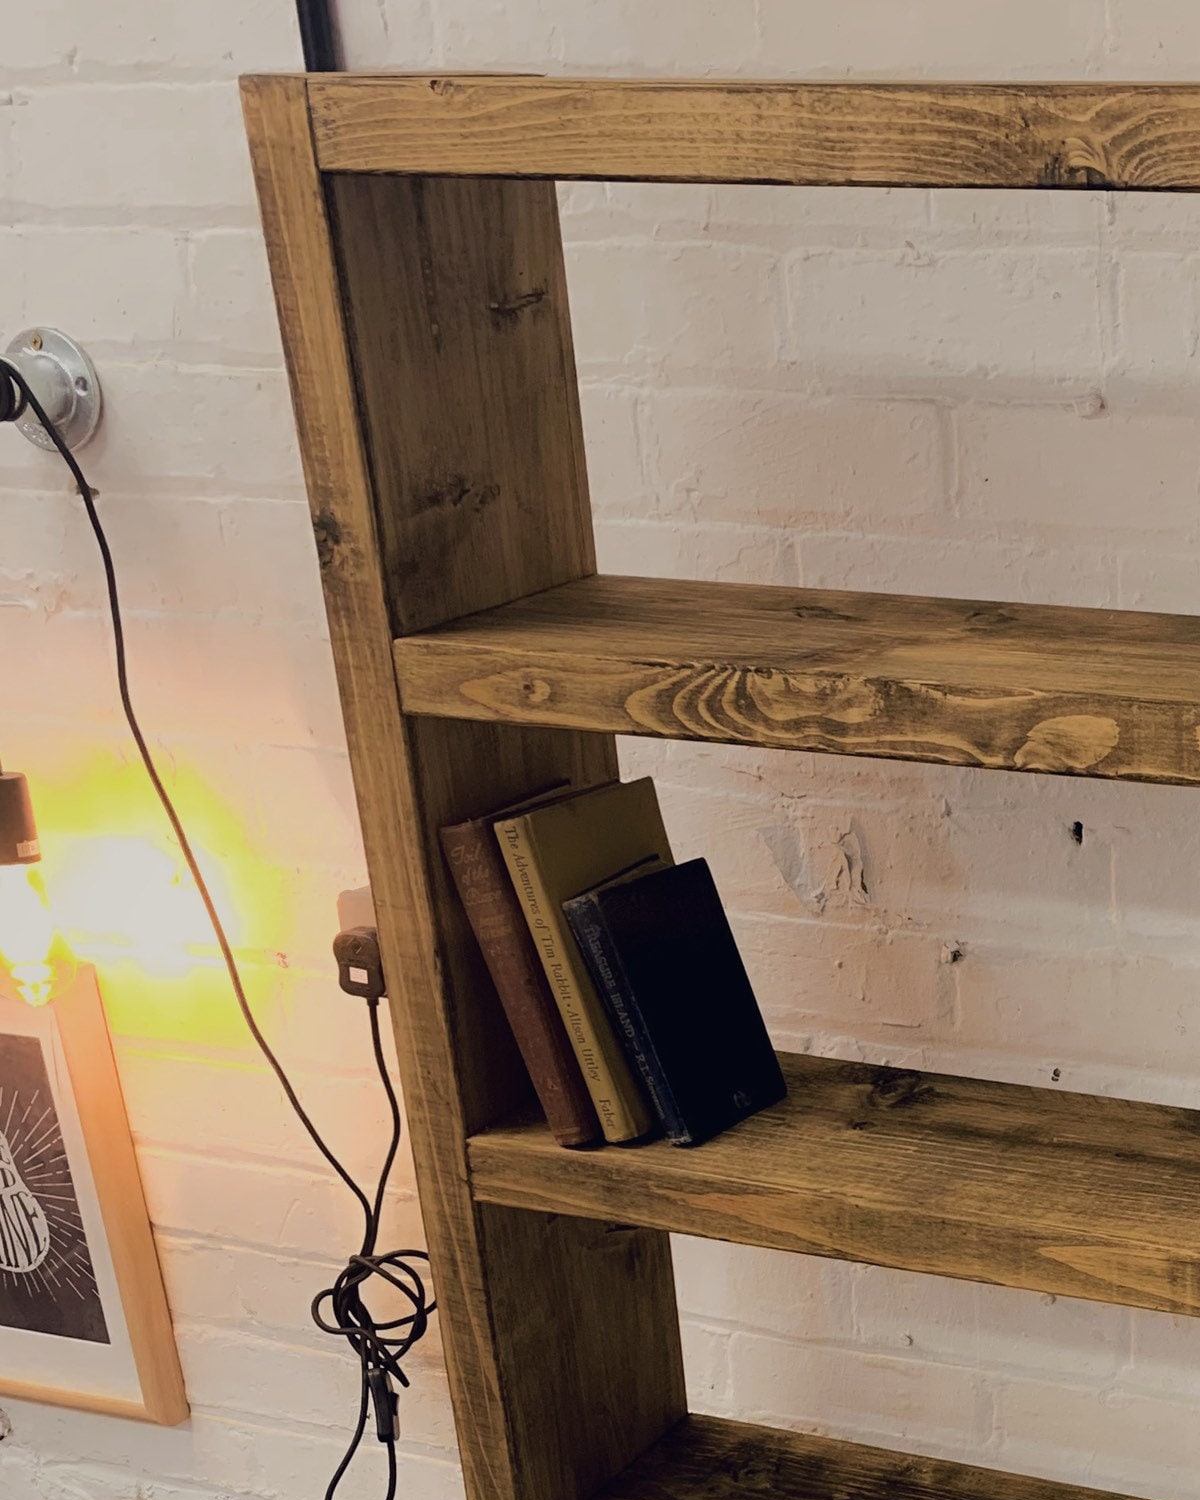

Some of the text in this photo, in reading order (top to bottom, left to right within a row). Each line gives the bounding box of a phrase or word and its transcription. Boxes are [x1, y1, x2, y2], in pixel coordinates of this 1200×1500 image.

[504, 825, 573, 1001] The Adventures of Tim Rabbit
[566, 1005, 602, 1083] Alison Uttley
[599, 1099, 616, 1129] Faber
